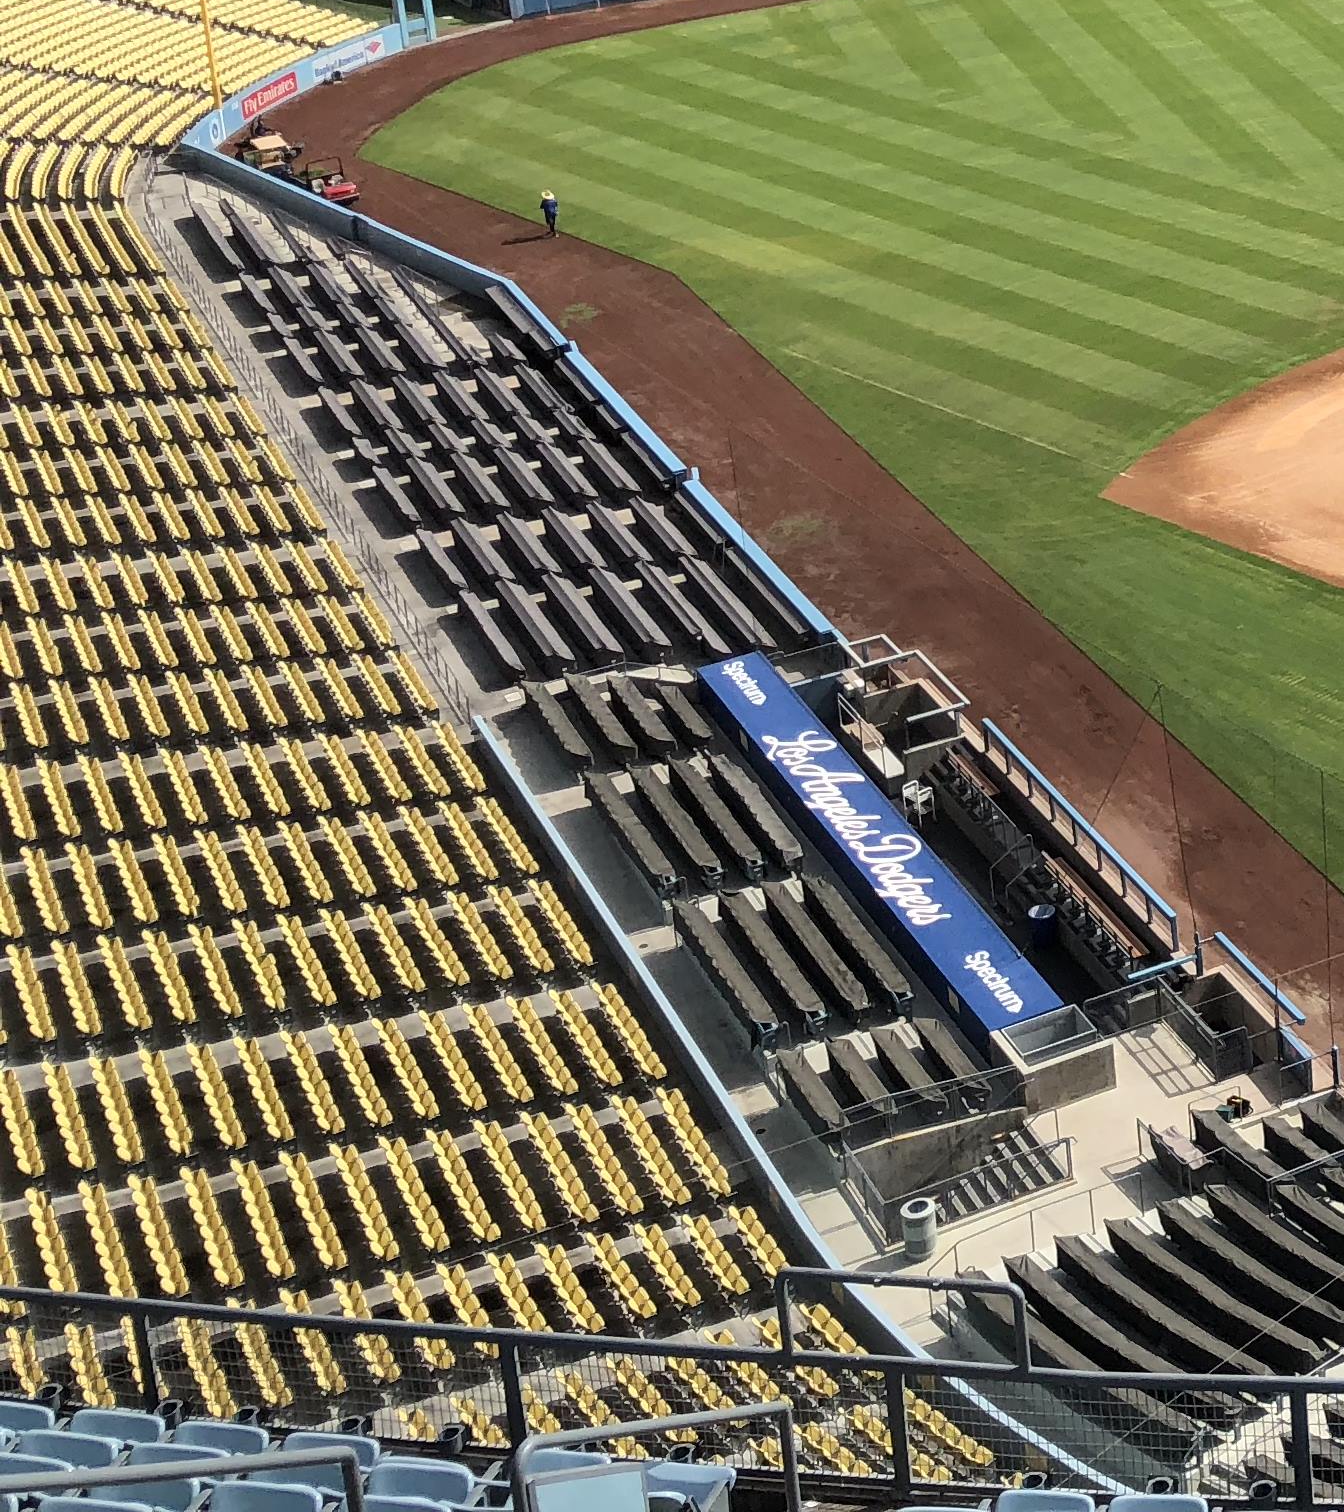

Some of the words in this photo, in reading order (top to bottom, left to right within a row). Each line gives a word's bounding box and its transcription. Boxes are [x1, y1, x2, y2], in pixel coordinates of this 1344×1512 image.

[243, 98, 258, 115] Fly
[257, 77, 296, 105] Emirates
[720, 659, 766, 706] Spectrum
[761, 730, 837, 767] Los
[789, 760, 883, 842] Angeles
[848, 833, 953, 926] Dodgers
[963, 950, 1023, 1014] Spectrum
